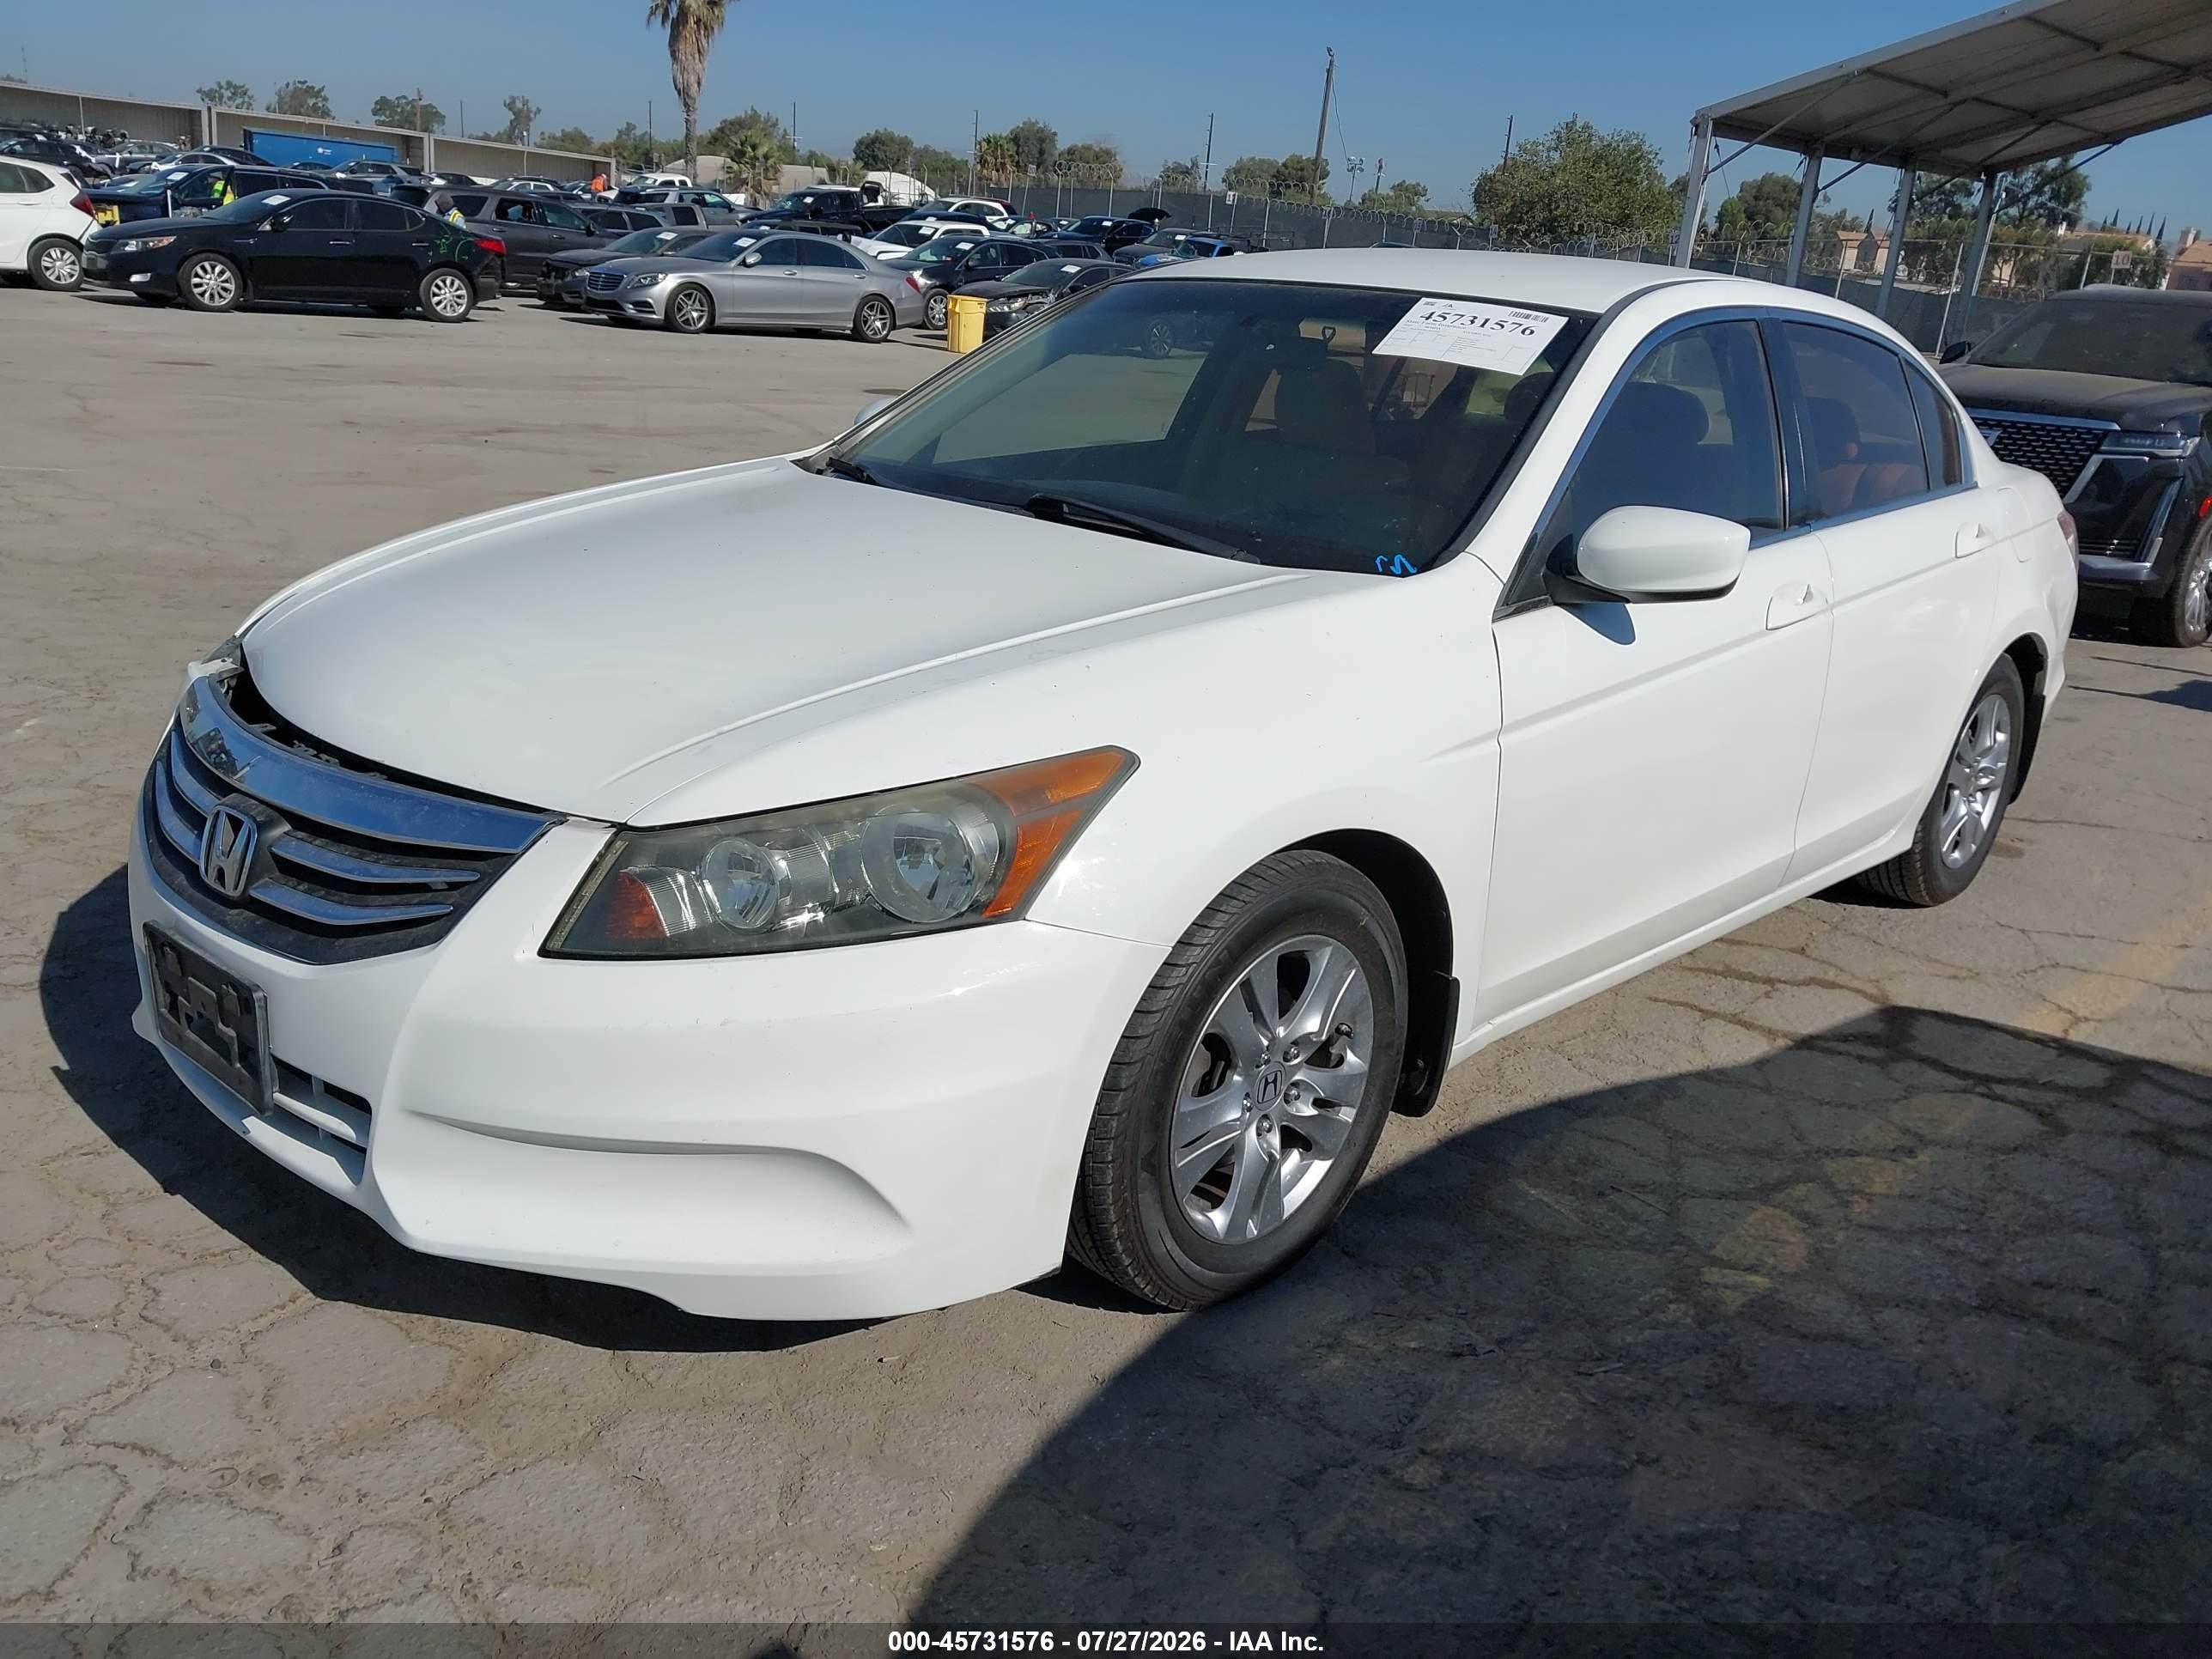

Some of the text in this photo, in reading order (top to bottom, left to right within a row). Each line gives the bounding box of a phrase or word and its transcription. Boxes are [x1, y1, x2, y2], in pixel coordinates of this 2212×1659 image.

[1669, 234, 1680, 245] 12
[2114, 255, 2130, 266] 10
[1419, 310, 1540, 336] 45731576
